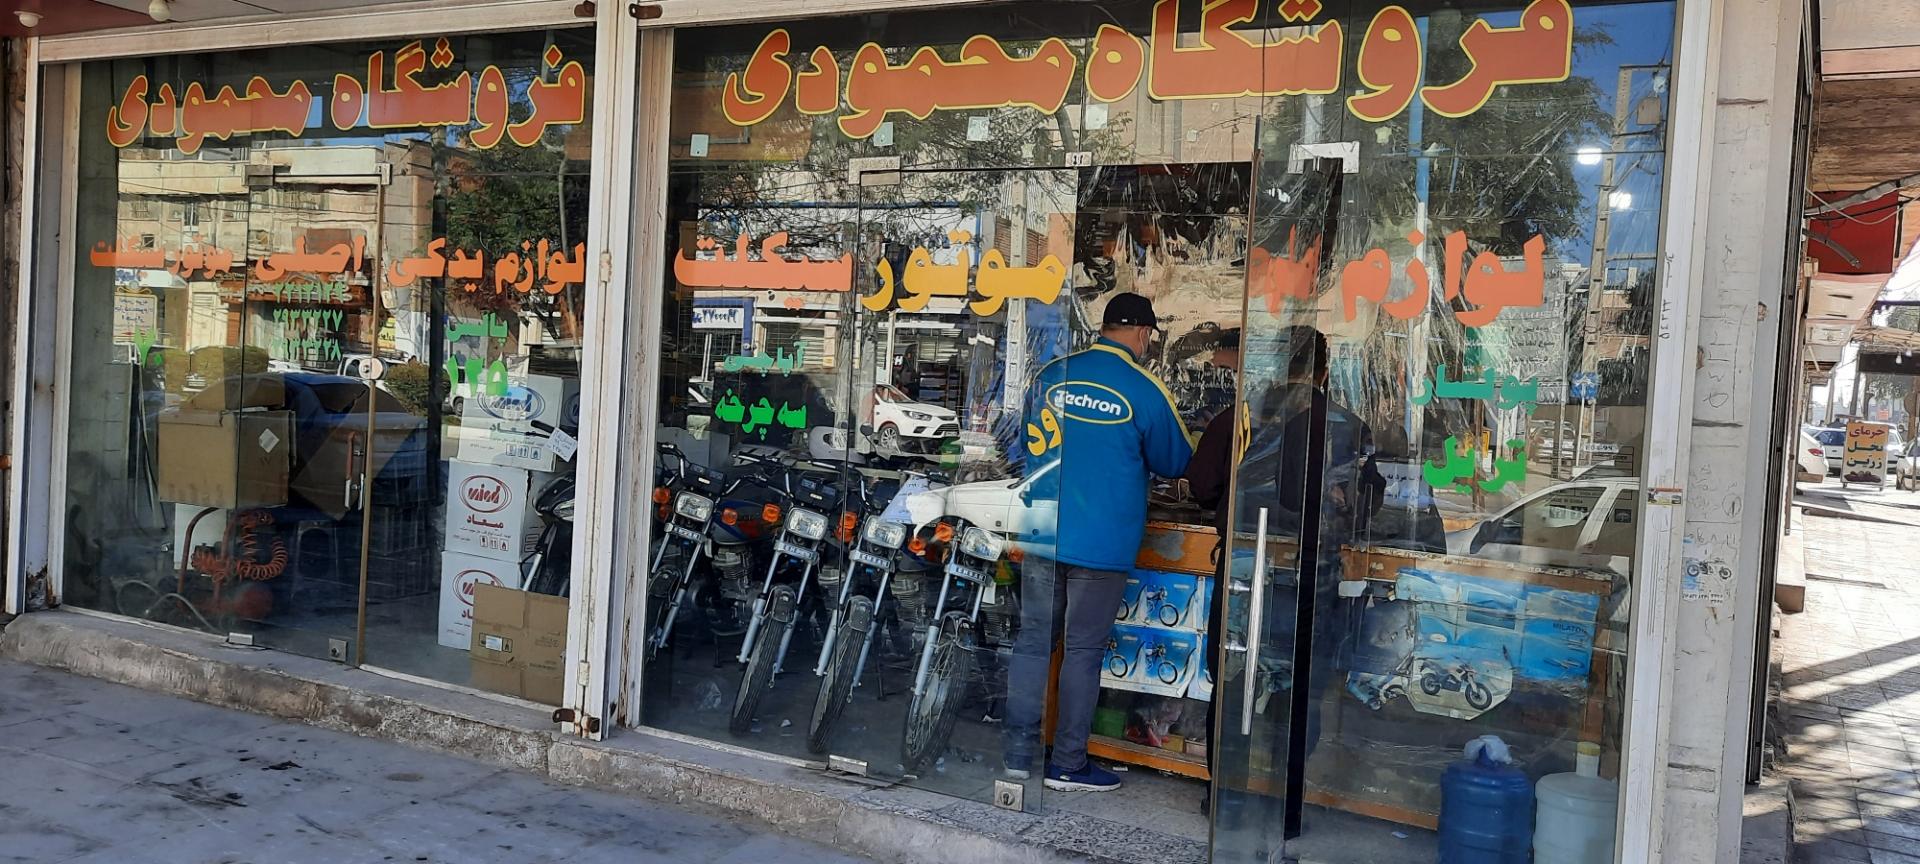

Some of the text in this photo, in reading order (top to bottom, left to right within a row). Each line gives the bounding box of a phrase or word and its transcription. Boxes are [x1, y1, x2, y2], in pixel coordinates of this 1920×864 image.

[106, 36, 586, 154] فروشگاه محمودی
[722, 28, 1077, 139] محمودی
[255, 235, 366, 281] اصلی
[387, 237, 484, 293] یدکی
[494, 237, 585, 295] لوازم
[674, 232, 852, 309] سیکلت
[860, 229, 1067, 317] موتور
[1341, 229, 1546, 327] لوازم
[447, 352, 509, 397] ۱۲۵
[1054, 389, 1122, 416] Techron
[1411, 363, 1539, 416] پولسار
[714, 387, 807, 440] سه چرخه
